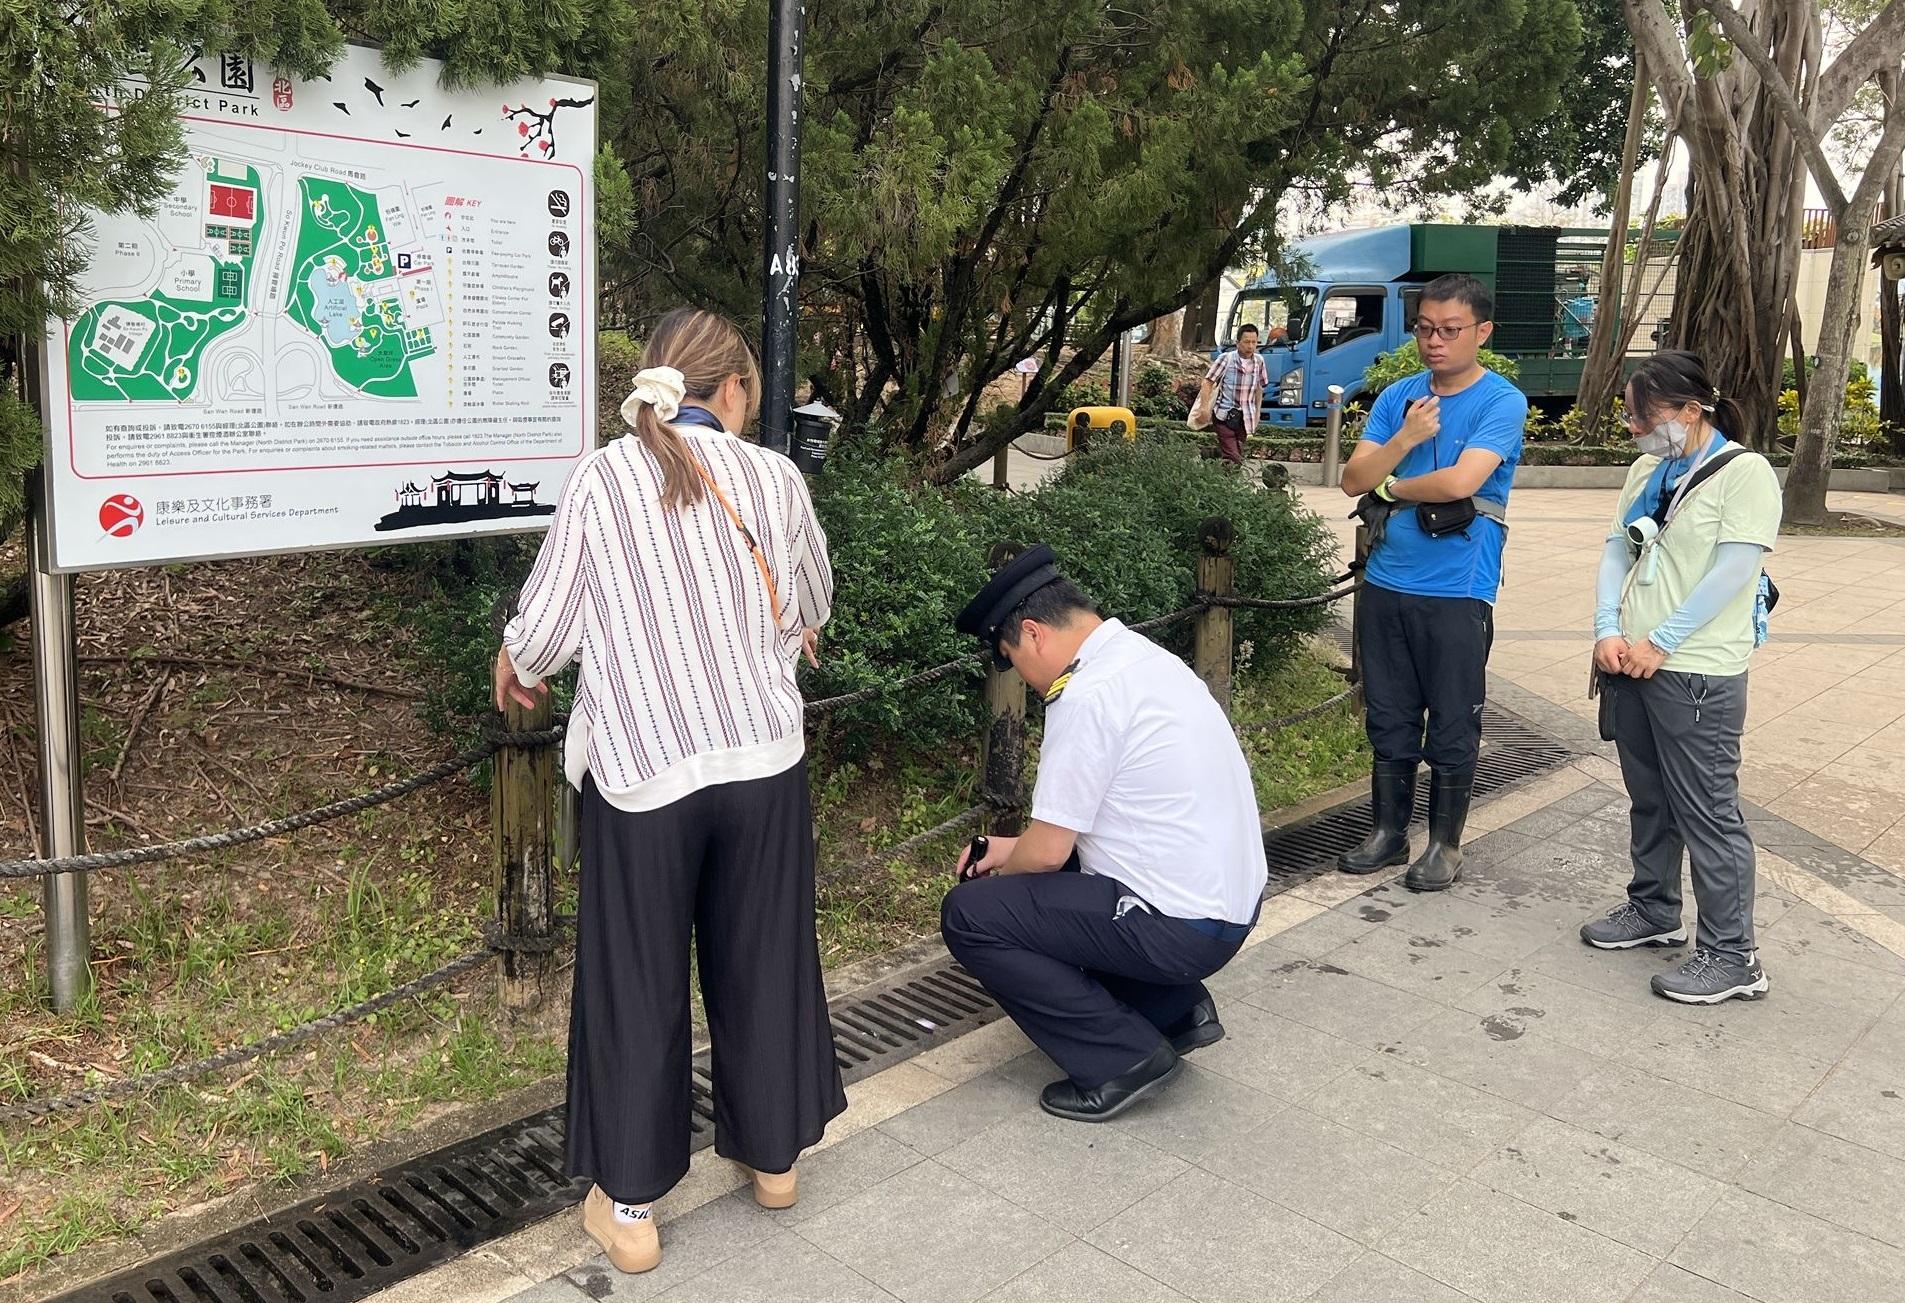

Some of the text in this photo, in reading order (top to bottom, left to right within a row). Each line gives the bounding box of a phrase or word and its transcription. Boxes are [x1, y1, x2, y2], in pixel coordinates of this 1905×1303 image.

[135, 88, 208, 110] Drict
[219, 100, 258, 116] Park
[274, 79, 292, 111] 北區
[290, 161, 312, 170] Jockey
[314, 164, 328, 172] Club
[330, 167, 346, 176] Road
[466, 200, 482, 208] KEY
[286, 210, 292, 219] So
[279, 241, 286, 250] Po
[275, 252, 283, 270] Road
[156, 494, 272, 515] 康樂及文化事務署
[156, 506, 339, 526] Leisure and Cultural Services Department
